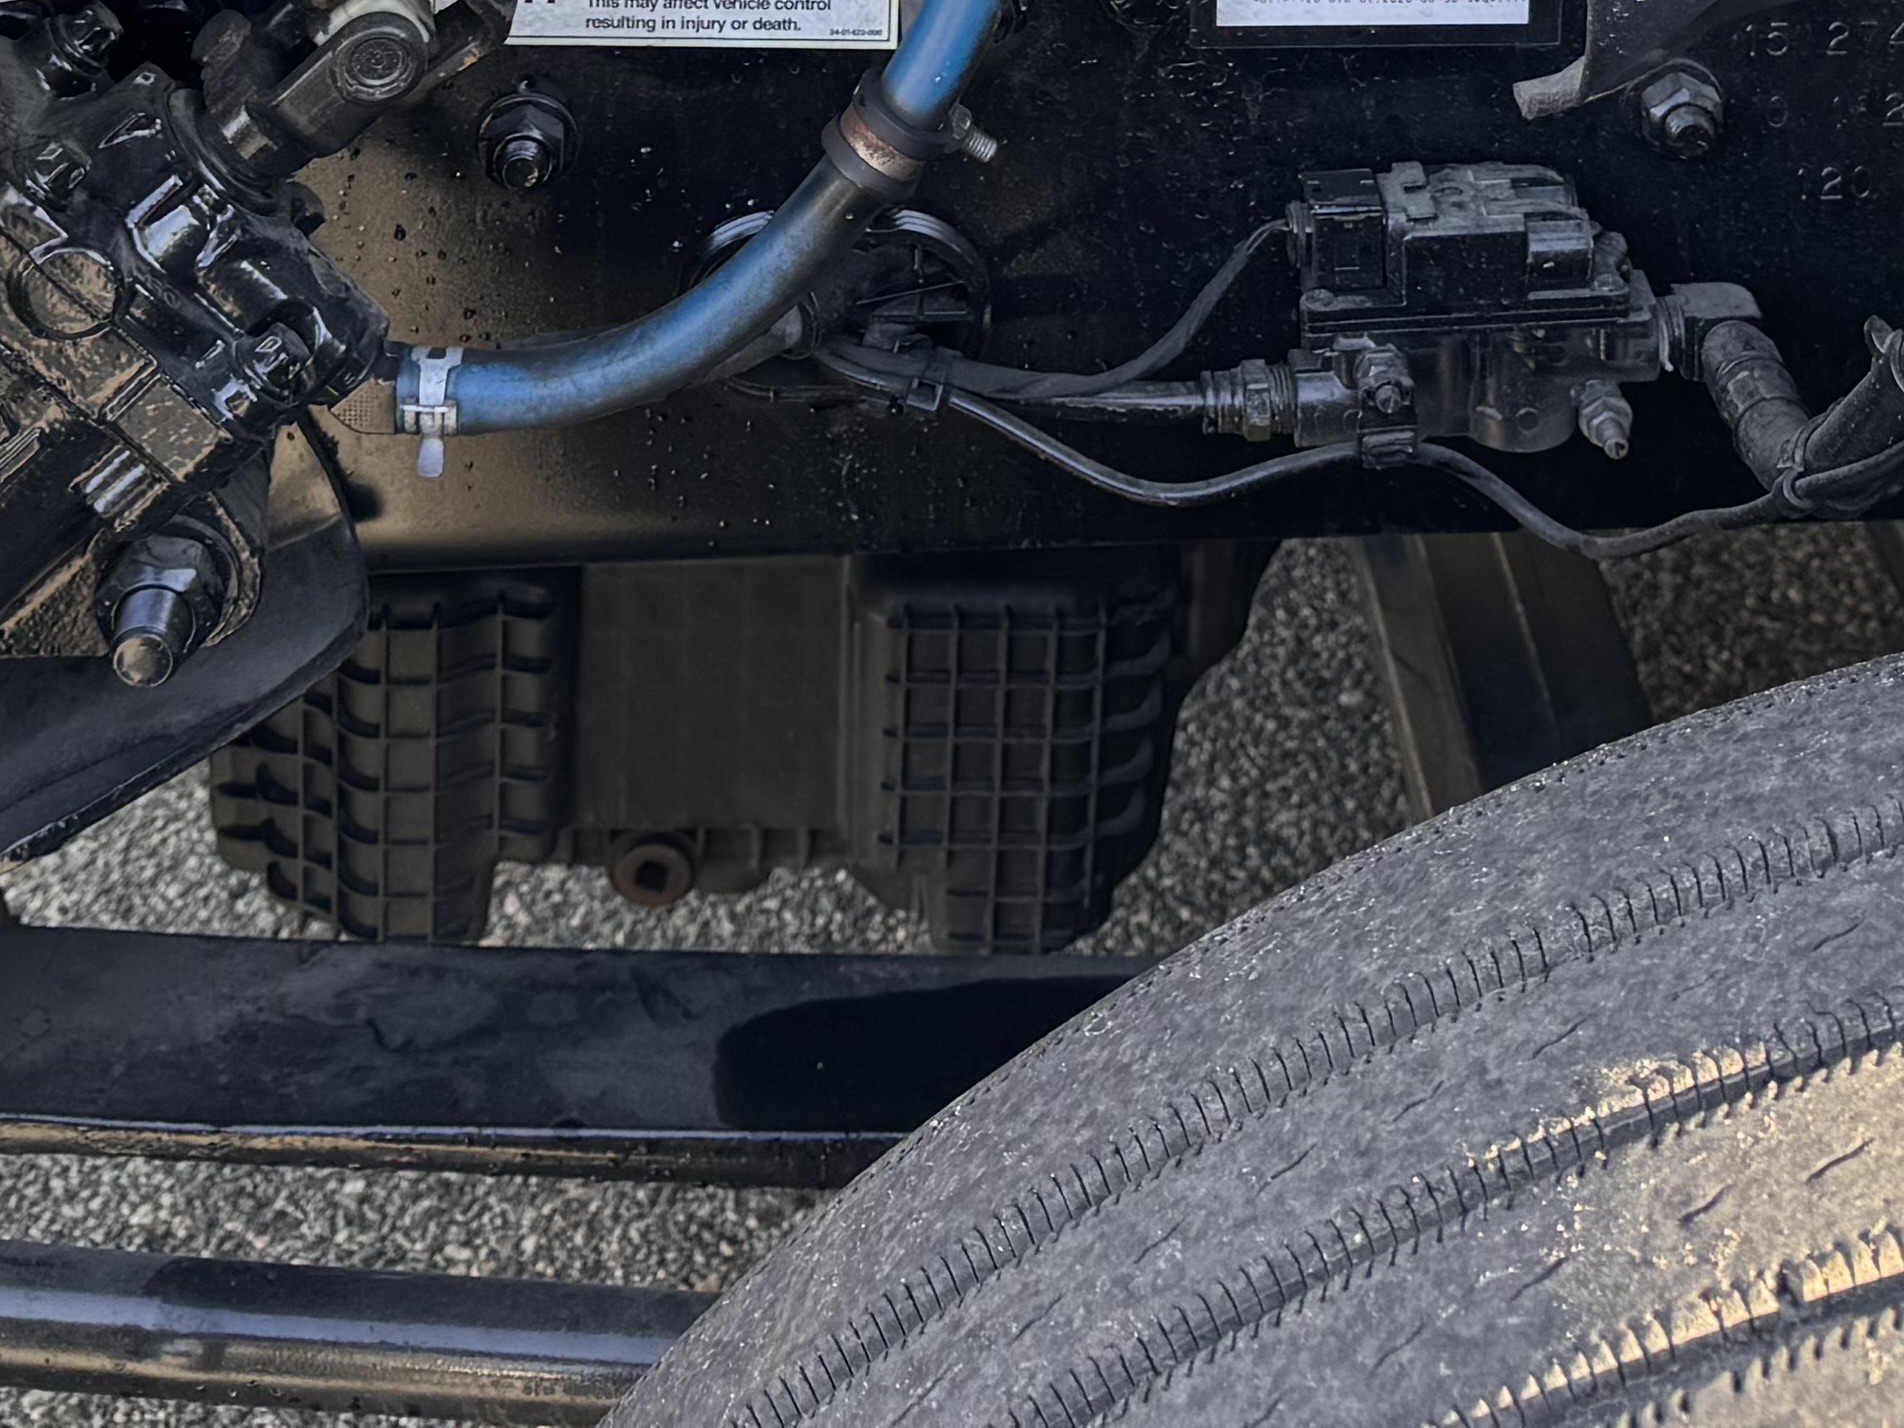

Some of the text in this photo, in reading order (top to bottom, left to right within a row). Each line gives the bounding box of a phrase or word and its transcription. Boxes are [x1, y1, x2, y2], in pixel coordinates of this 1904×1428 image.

[584, 14, 802, 35] resulting in injury or death.
